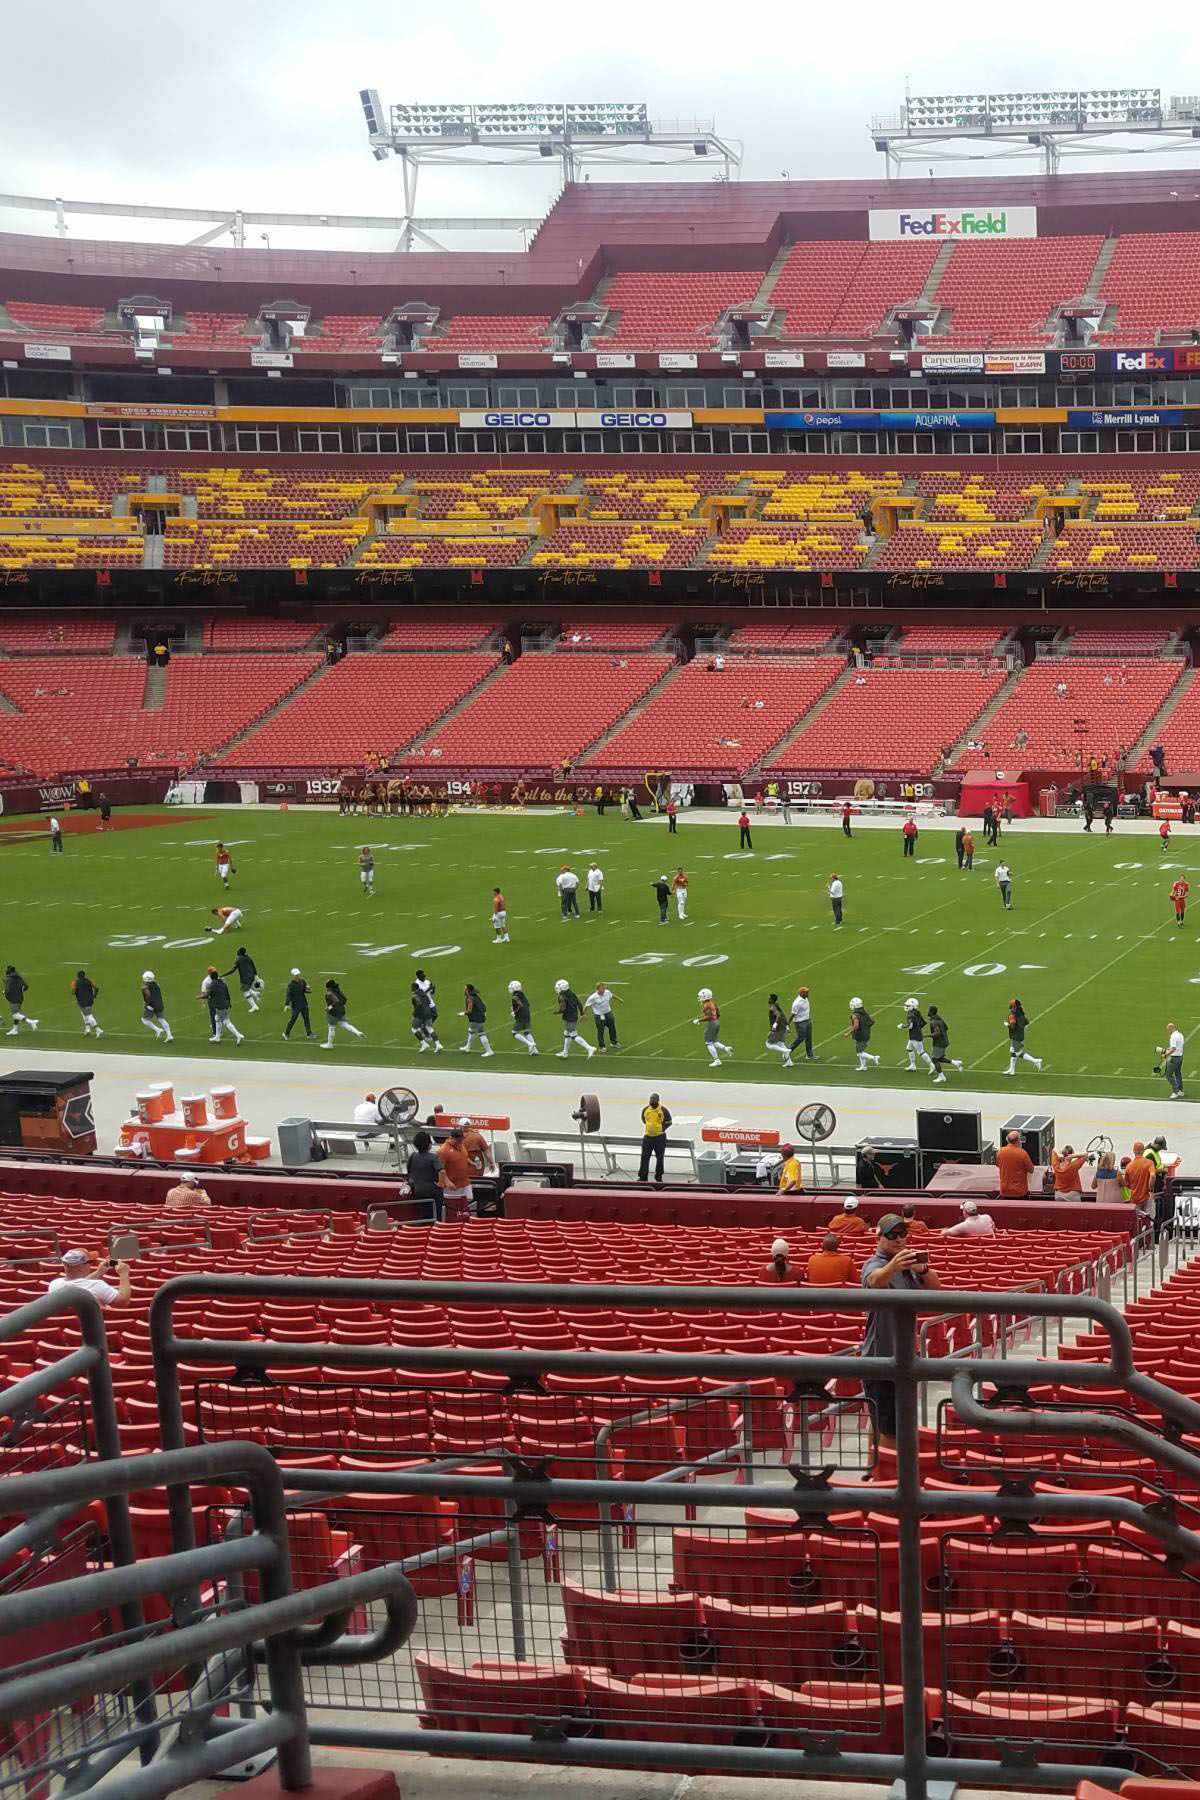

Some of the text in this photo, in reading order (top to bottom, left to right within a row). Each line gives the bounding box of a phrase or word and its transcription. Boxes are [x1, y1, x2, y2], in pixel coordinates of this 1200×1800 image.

[899, 213, 1006, 236] FedExField
[924, 355, 972, 366] Carpetland
[1062, 355, 1094, 368] 90:00
[1116, 352, 1166, 370] FedEx
[484, 414, 551, 427] GEICO
[600, 414, 667, 427] GEICO
[815, 415, 841, 427] pepsi
[915, 414, 961, 428] AQUAFINA
[1104, 413, 1160, 425] Merrill Lynch
[305, 781, 342, 794] 1937
[540, 787, 553, 801] to
[555, 786, 573, 801] the
[107, 935, 215, 949] 30
[356, 944, 462, 958] 40
[618, 952, 730, 967] 50
[900, 961, 1007, 977] 40
[138, 1103, 146, 1113] G
[213, 1099, 221, 1109] G
[183, 1106, 191, 1116] G
[450, 1118, 489, 1127] GARADE
[227, 1134, 239, 1151] G
[719, 1132, 761, 1141] GATORADE
